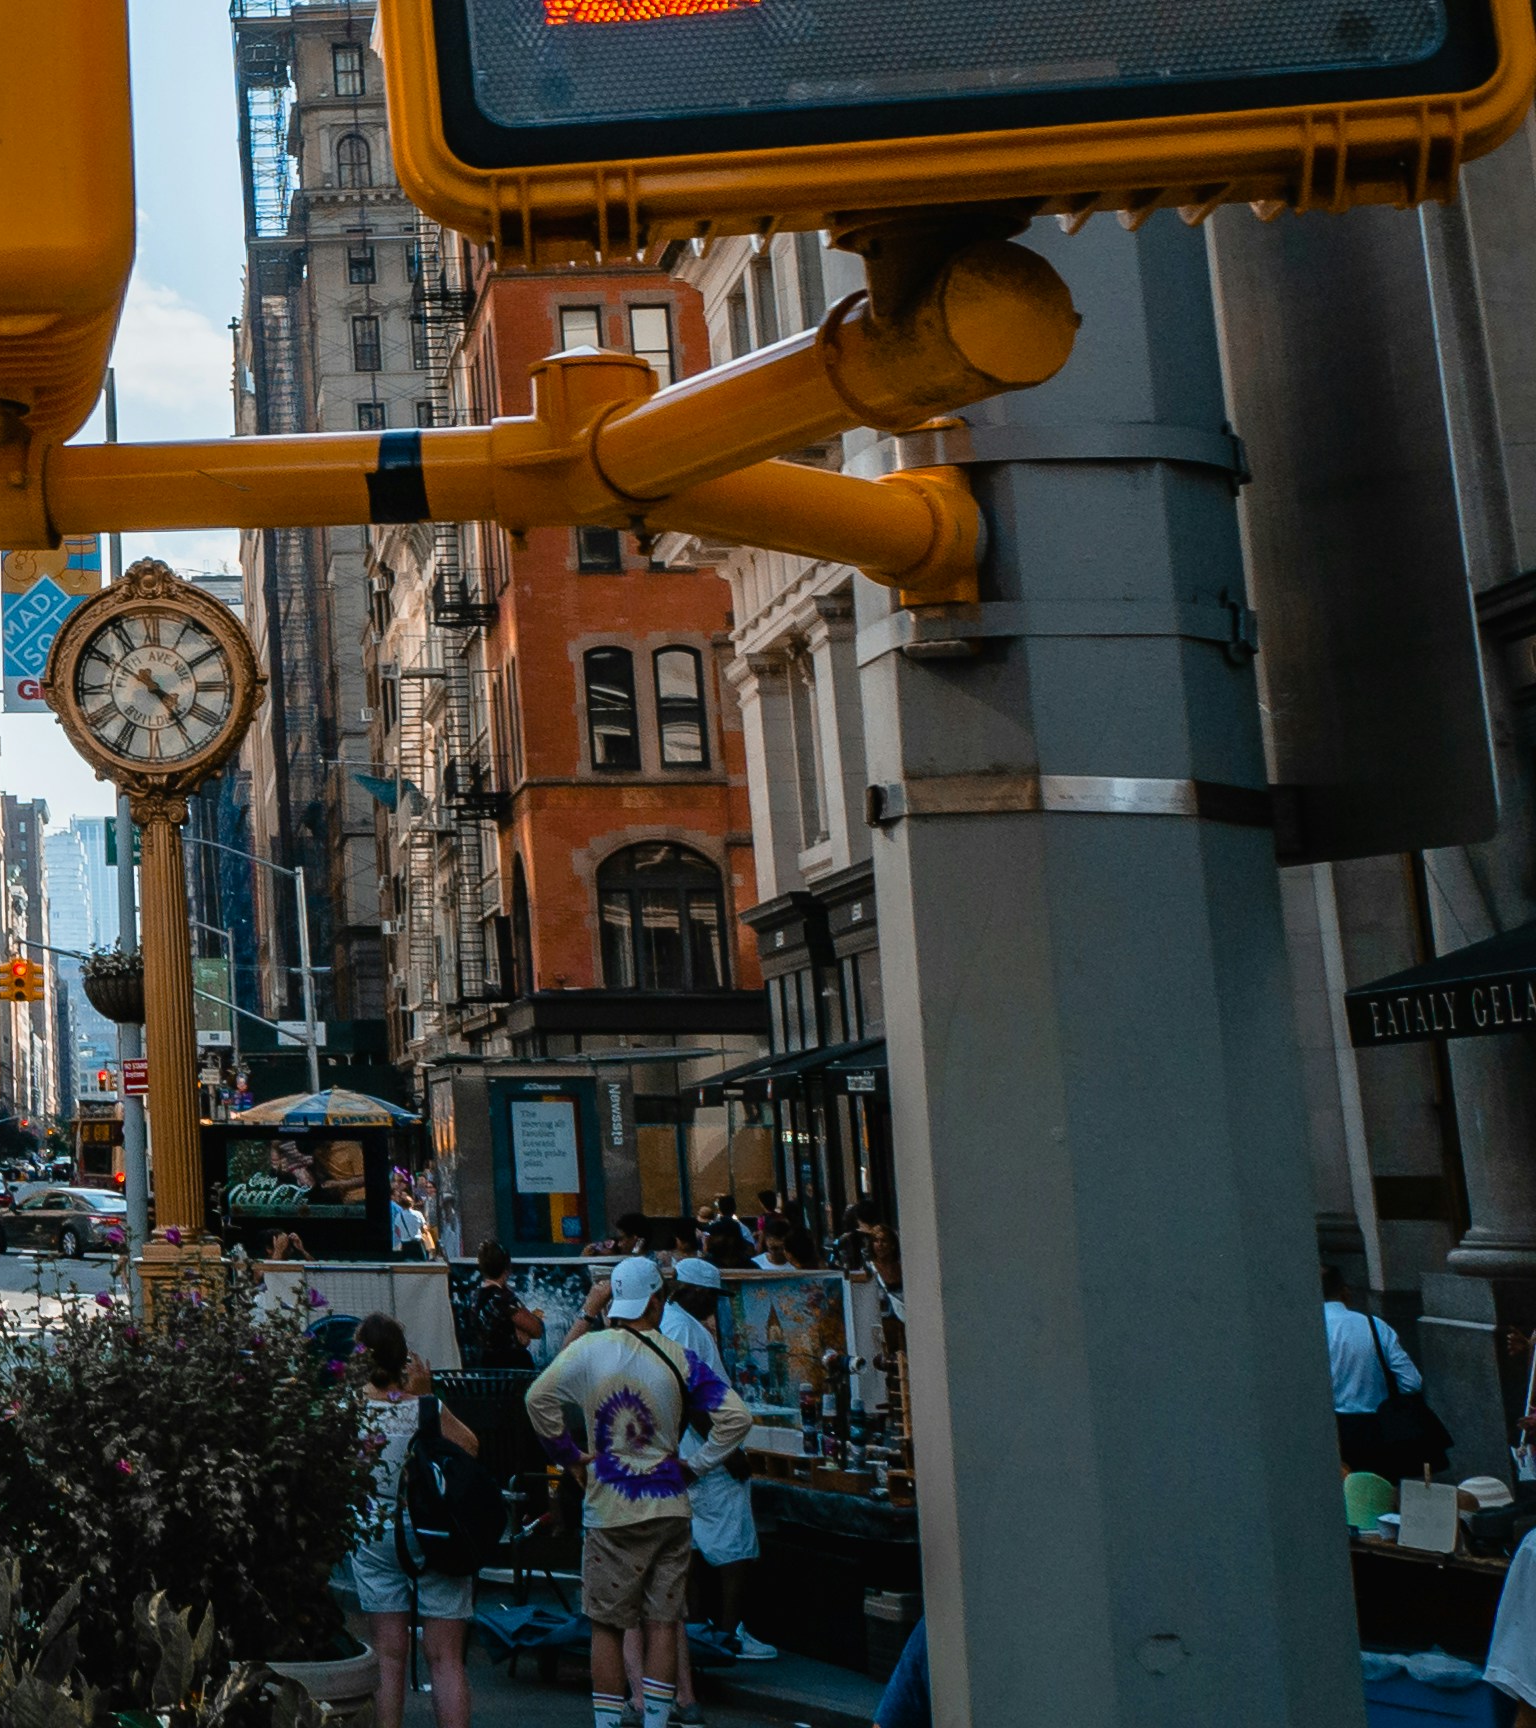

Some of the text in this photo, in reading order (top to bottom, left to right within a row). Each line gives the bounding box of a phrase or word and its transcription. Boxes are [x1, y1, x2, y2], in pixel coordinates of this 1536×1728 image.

[124, 704, 188, 727] BUILDIG
[1369, 991, 1457, 1037] EATALY
[608, 1083, 624, 1146] Newssta
